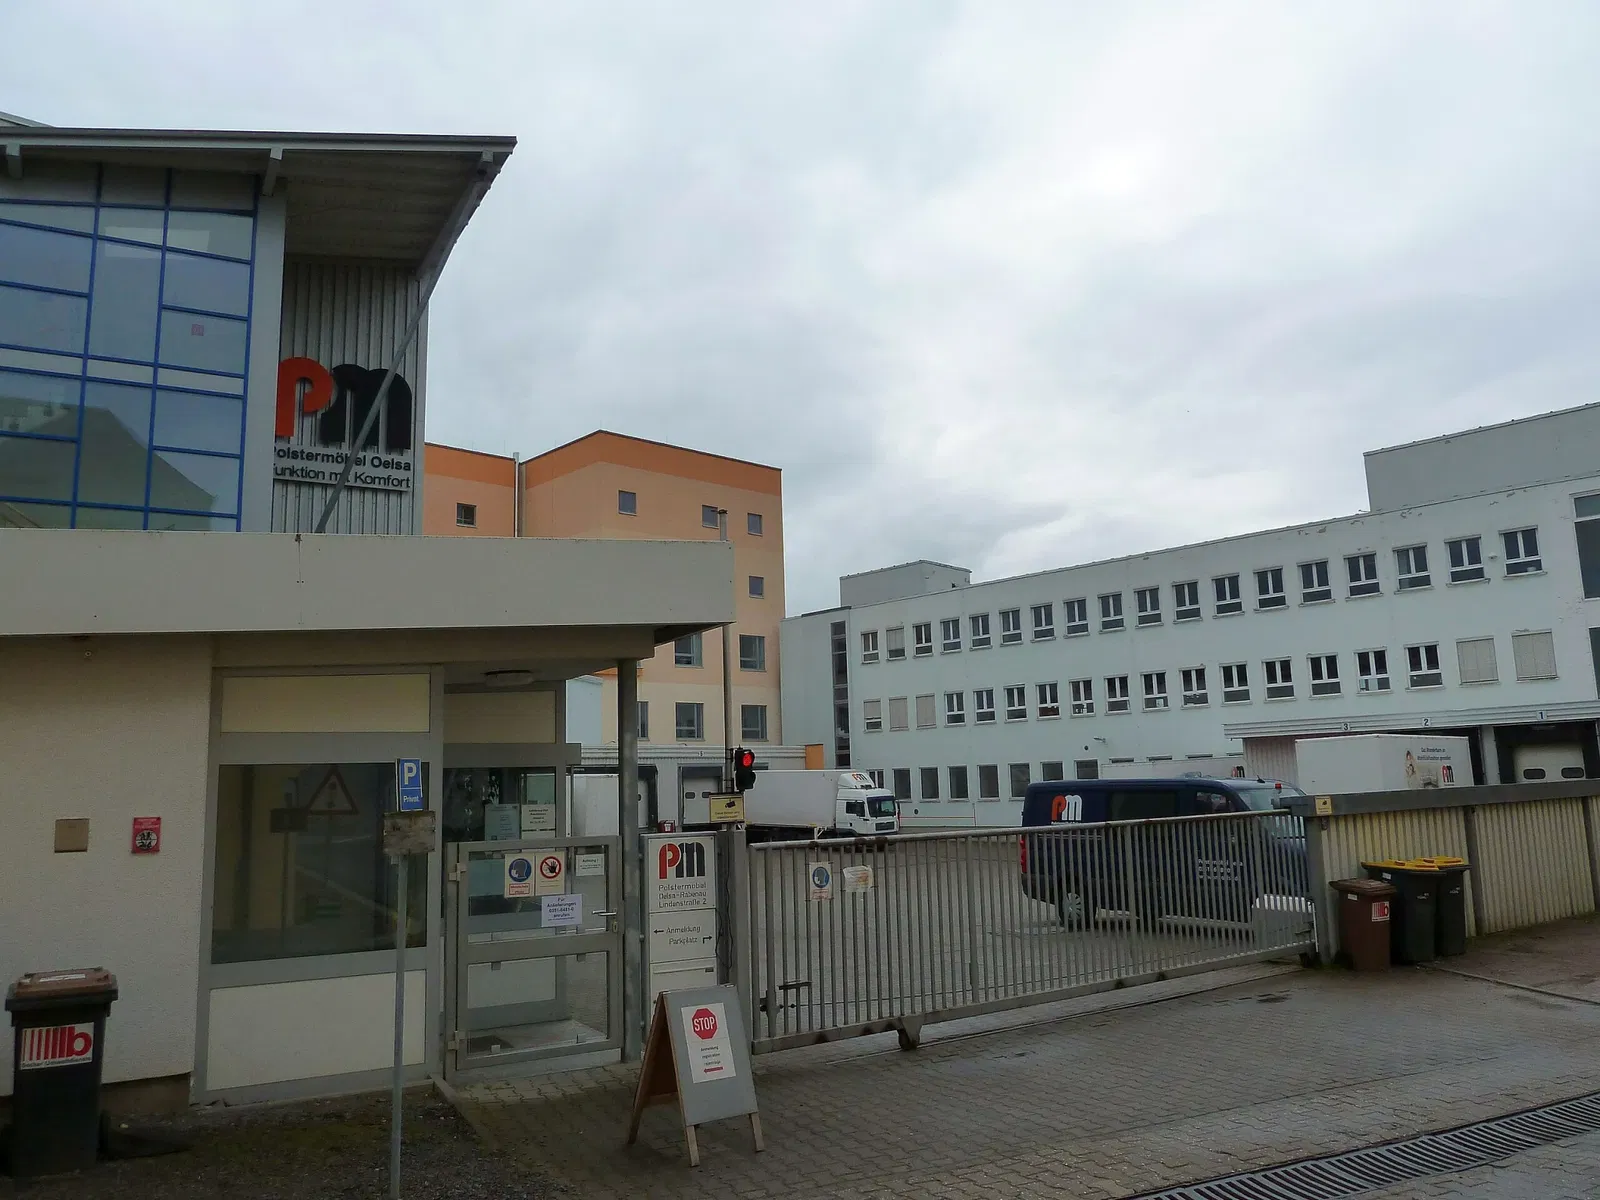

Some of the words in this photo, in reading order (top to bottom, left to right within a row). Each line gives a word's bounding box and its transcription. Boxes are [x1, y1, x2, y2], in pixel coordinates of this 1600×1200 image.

[274, 446, 366, 467] olstermöel
[371, 456, 411, 471] Oelsa
[273, 463, 326, 481] unktion
[354, 472, 411, 488] Komfort
[1539, 711, 1543, 720] 1
[1424, 718, 1429, 726] 2
[1343, 723, 1348, 731] 3
[404, 762, 417, 785] P
[666, 926, 701, 934] Anmeldung
[668, 937, 698, 945] Parkplatz
[693, 1016, 715, 1031] STOP
